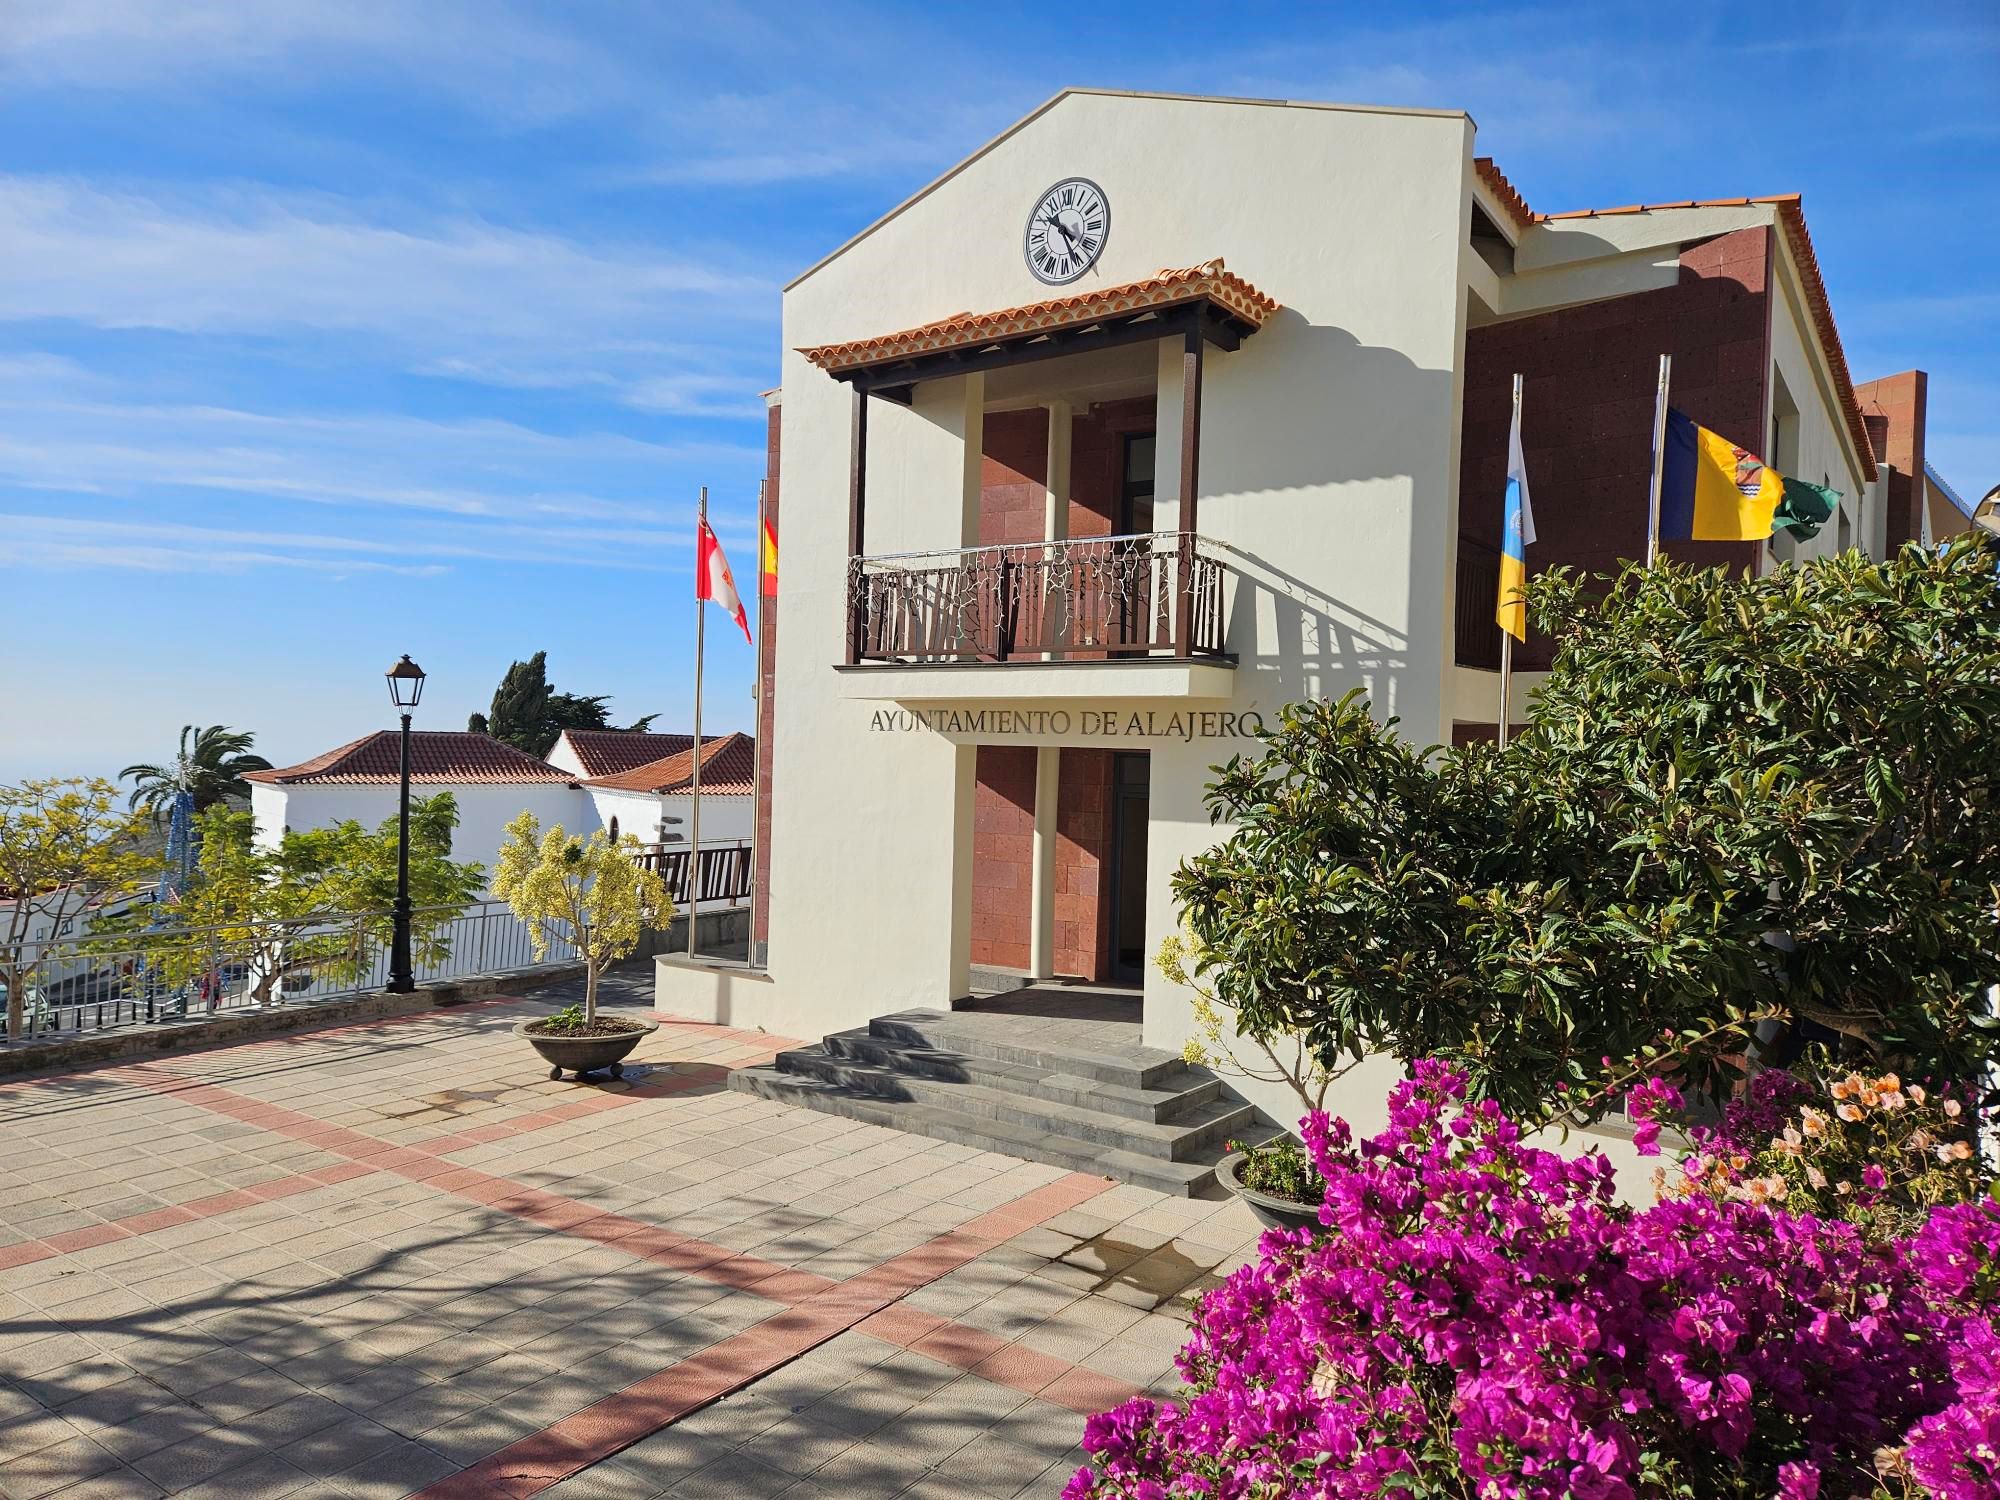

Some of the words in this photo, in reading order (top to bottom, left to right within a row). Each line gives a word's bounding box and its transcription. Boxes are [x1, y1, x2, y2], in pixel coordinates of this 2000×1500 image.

[869, 710, 1071, 735] AYUNTAMIENTO
[1080, 711, 1117, 736] DE
[1123, 700, 1263, 743] ALAJERÓ
